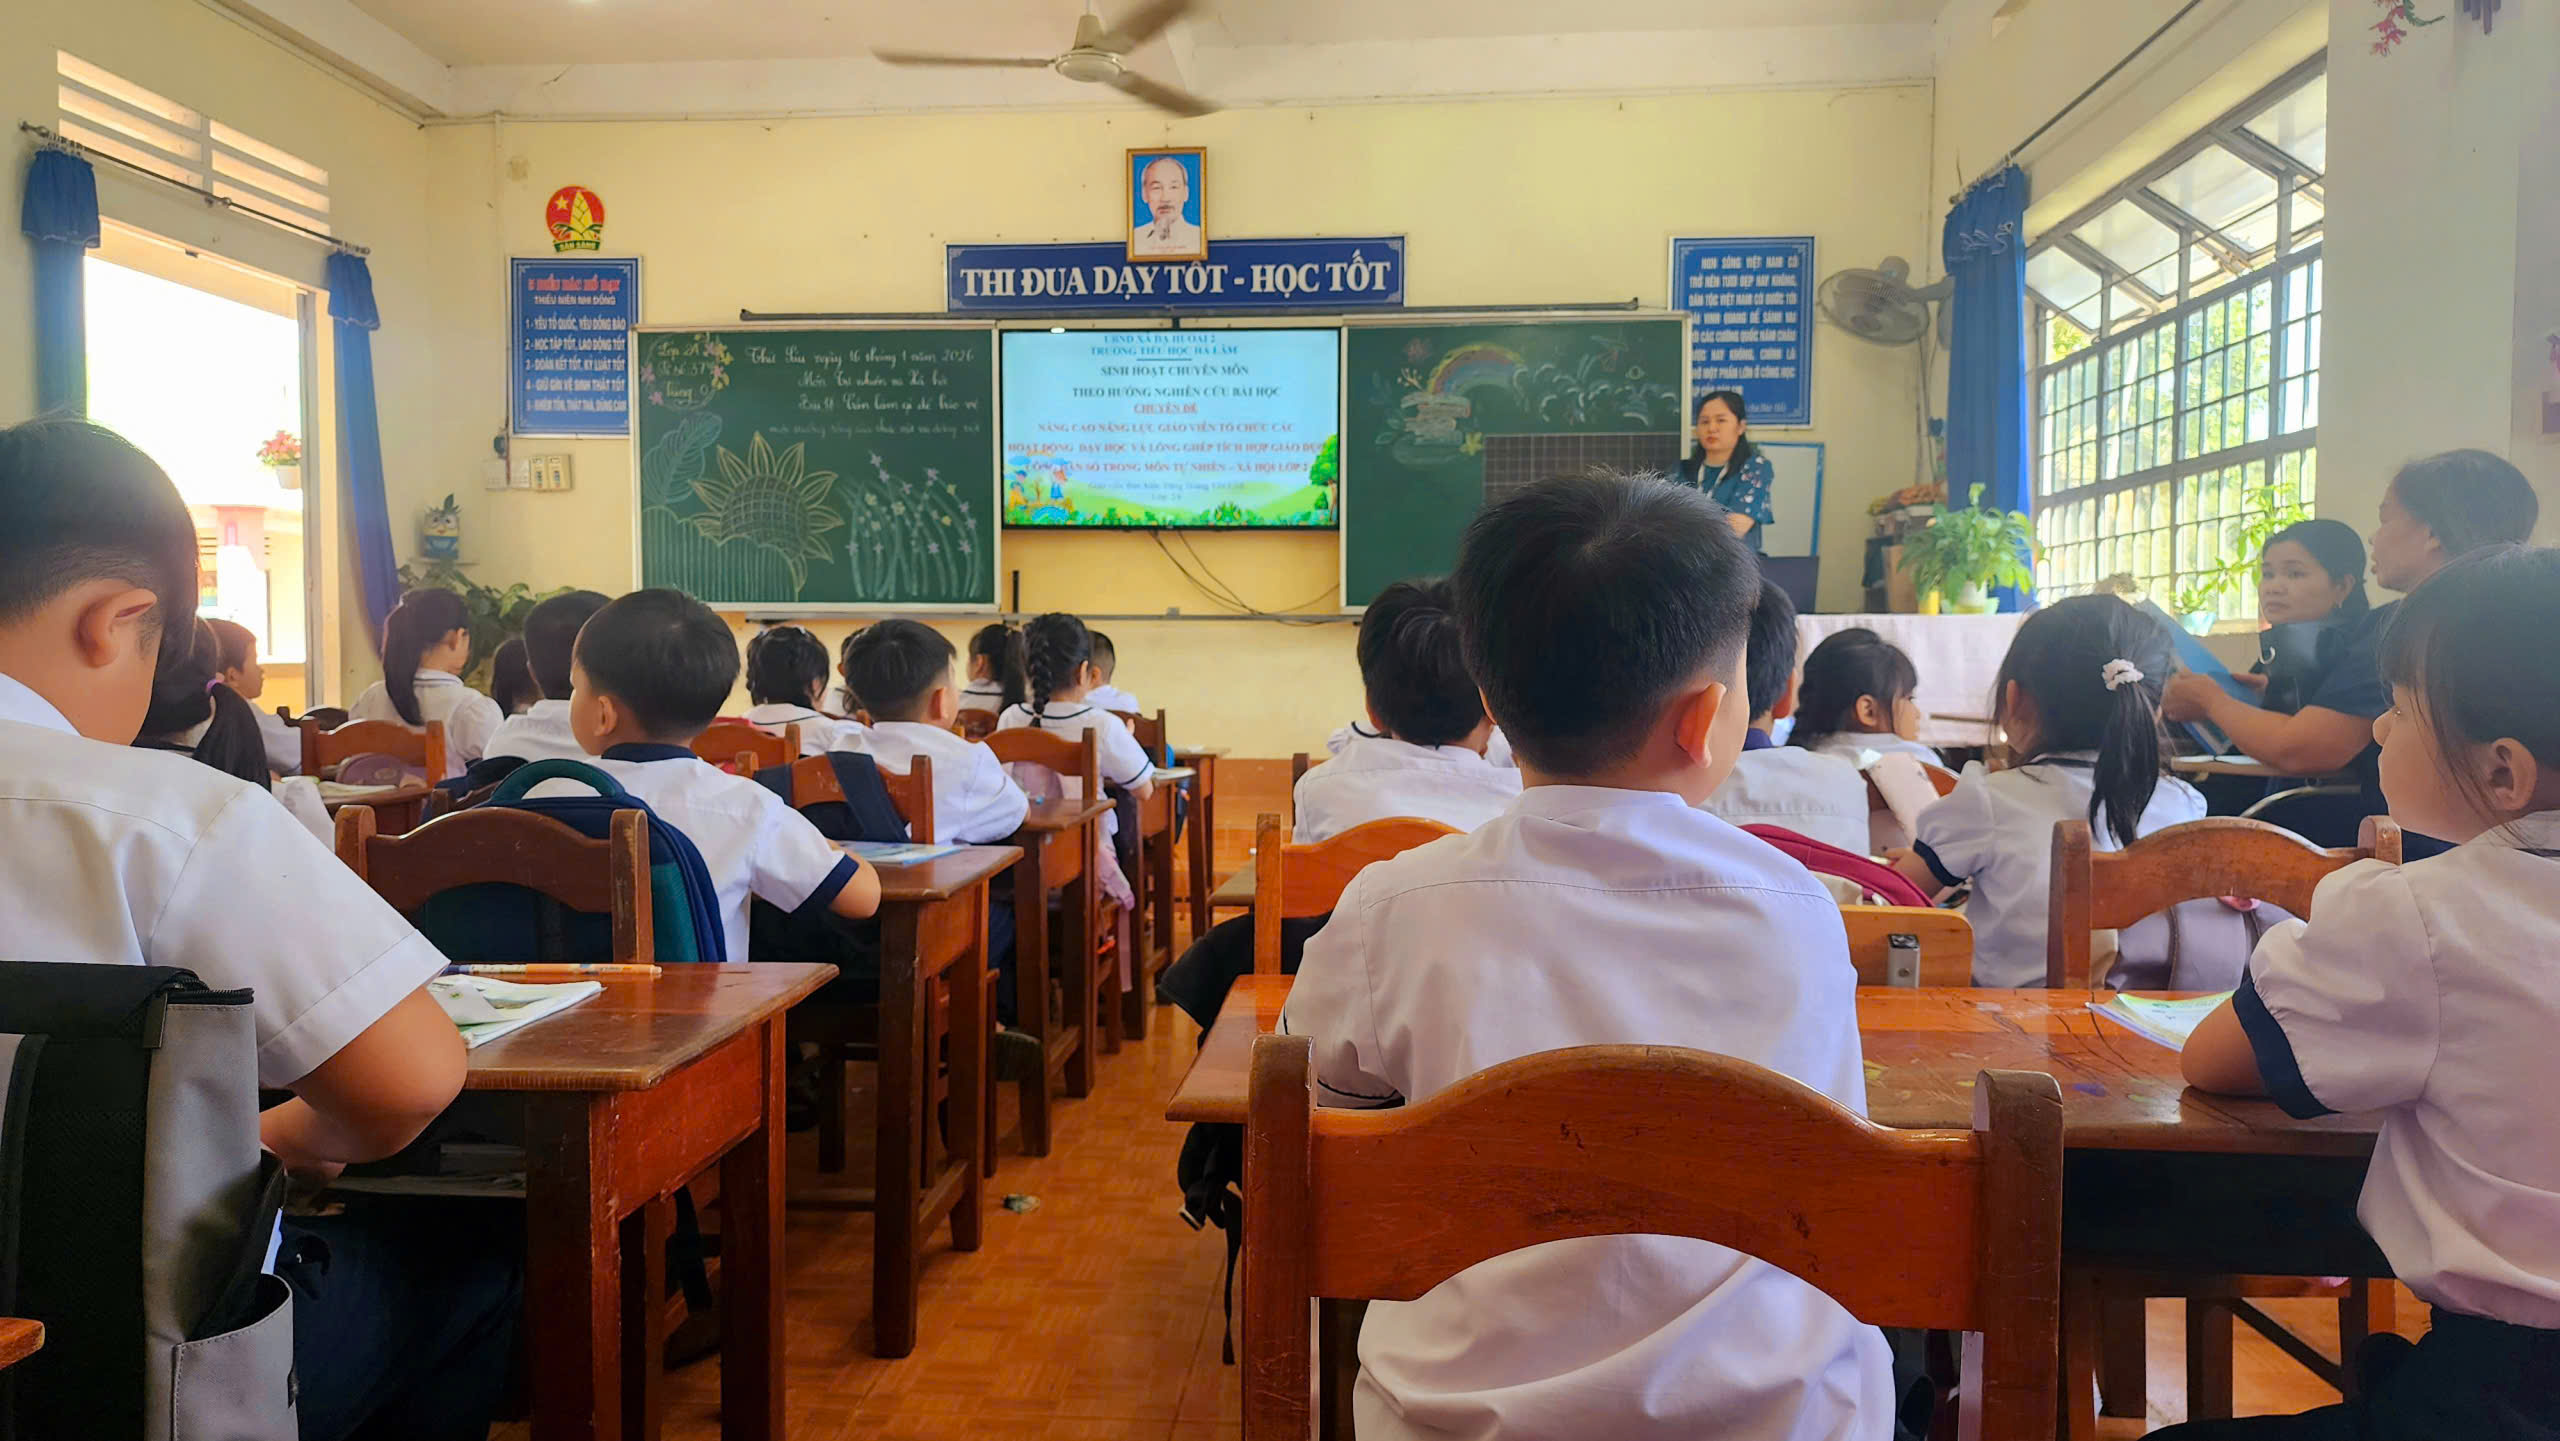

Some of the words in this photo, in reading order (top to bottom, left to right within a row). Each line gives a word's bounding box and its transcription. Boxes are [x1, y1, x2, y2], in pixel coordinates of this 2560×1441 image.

[960, 267, 1016, 297] THI
[1020, 265, 1089, 297] ĐUA
[1093, 264, 1167, 300] DẠY
[1250, 263, 1320, 299] HỌC
[1325, 249, 1392, 292] TỐT
